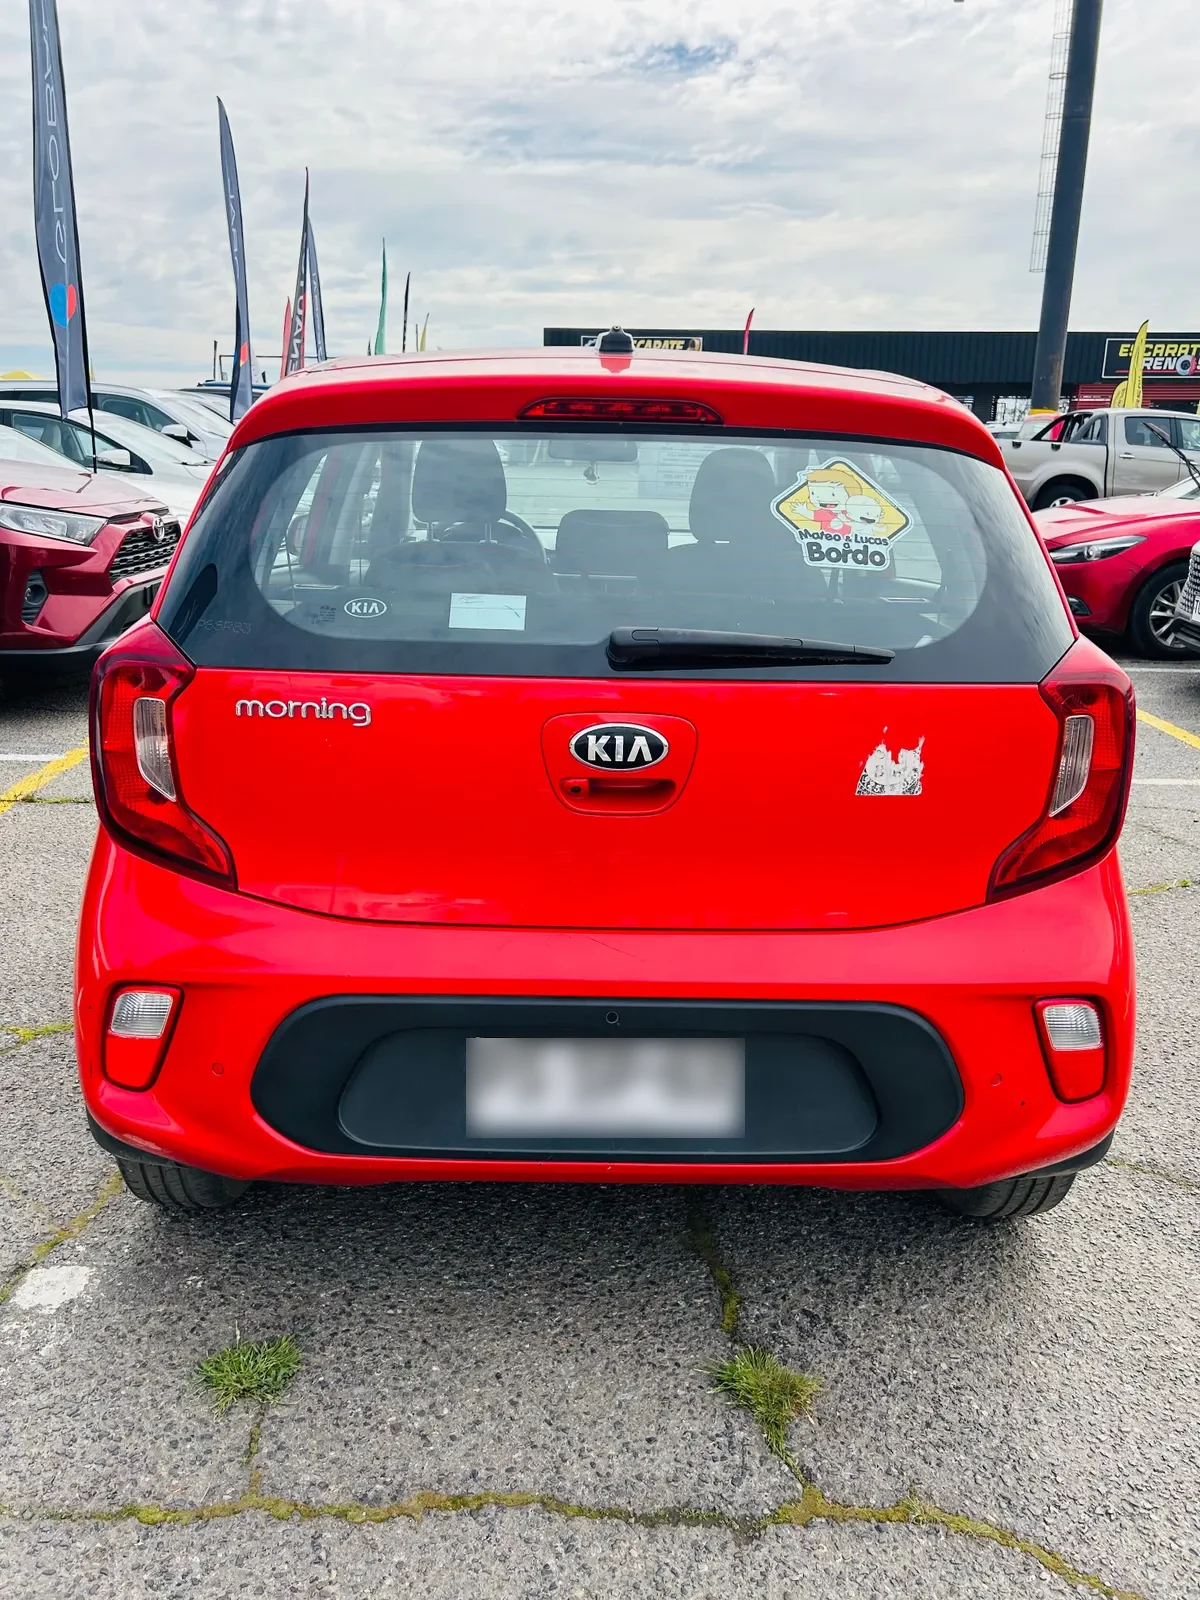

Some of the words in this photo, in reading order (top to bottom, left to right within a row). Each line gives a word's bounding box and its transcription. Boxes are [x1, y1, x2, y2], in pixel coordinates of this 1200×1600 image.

[798, 528, 841, 541] Mateo
[845, 535, 853, 543] &
[854, 533, 889, 546] Lucas
[806, 541, 886, 566] Bordo
[352, 603, 380, 614] KIA
[235, 697, 371, 727] morning
[587, 735, 653, 762] KIA
